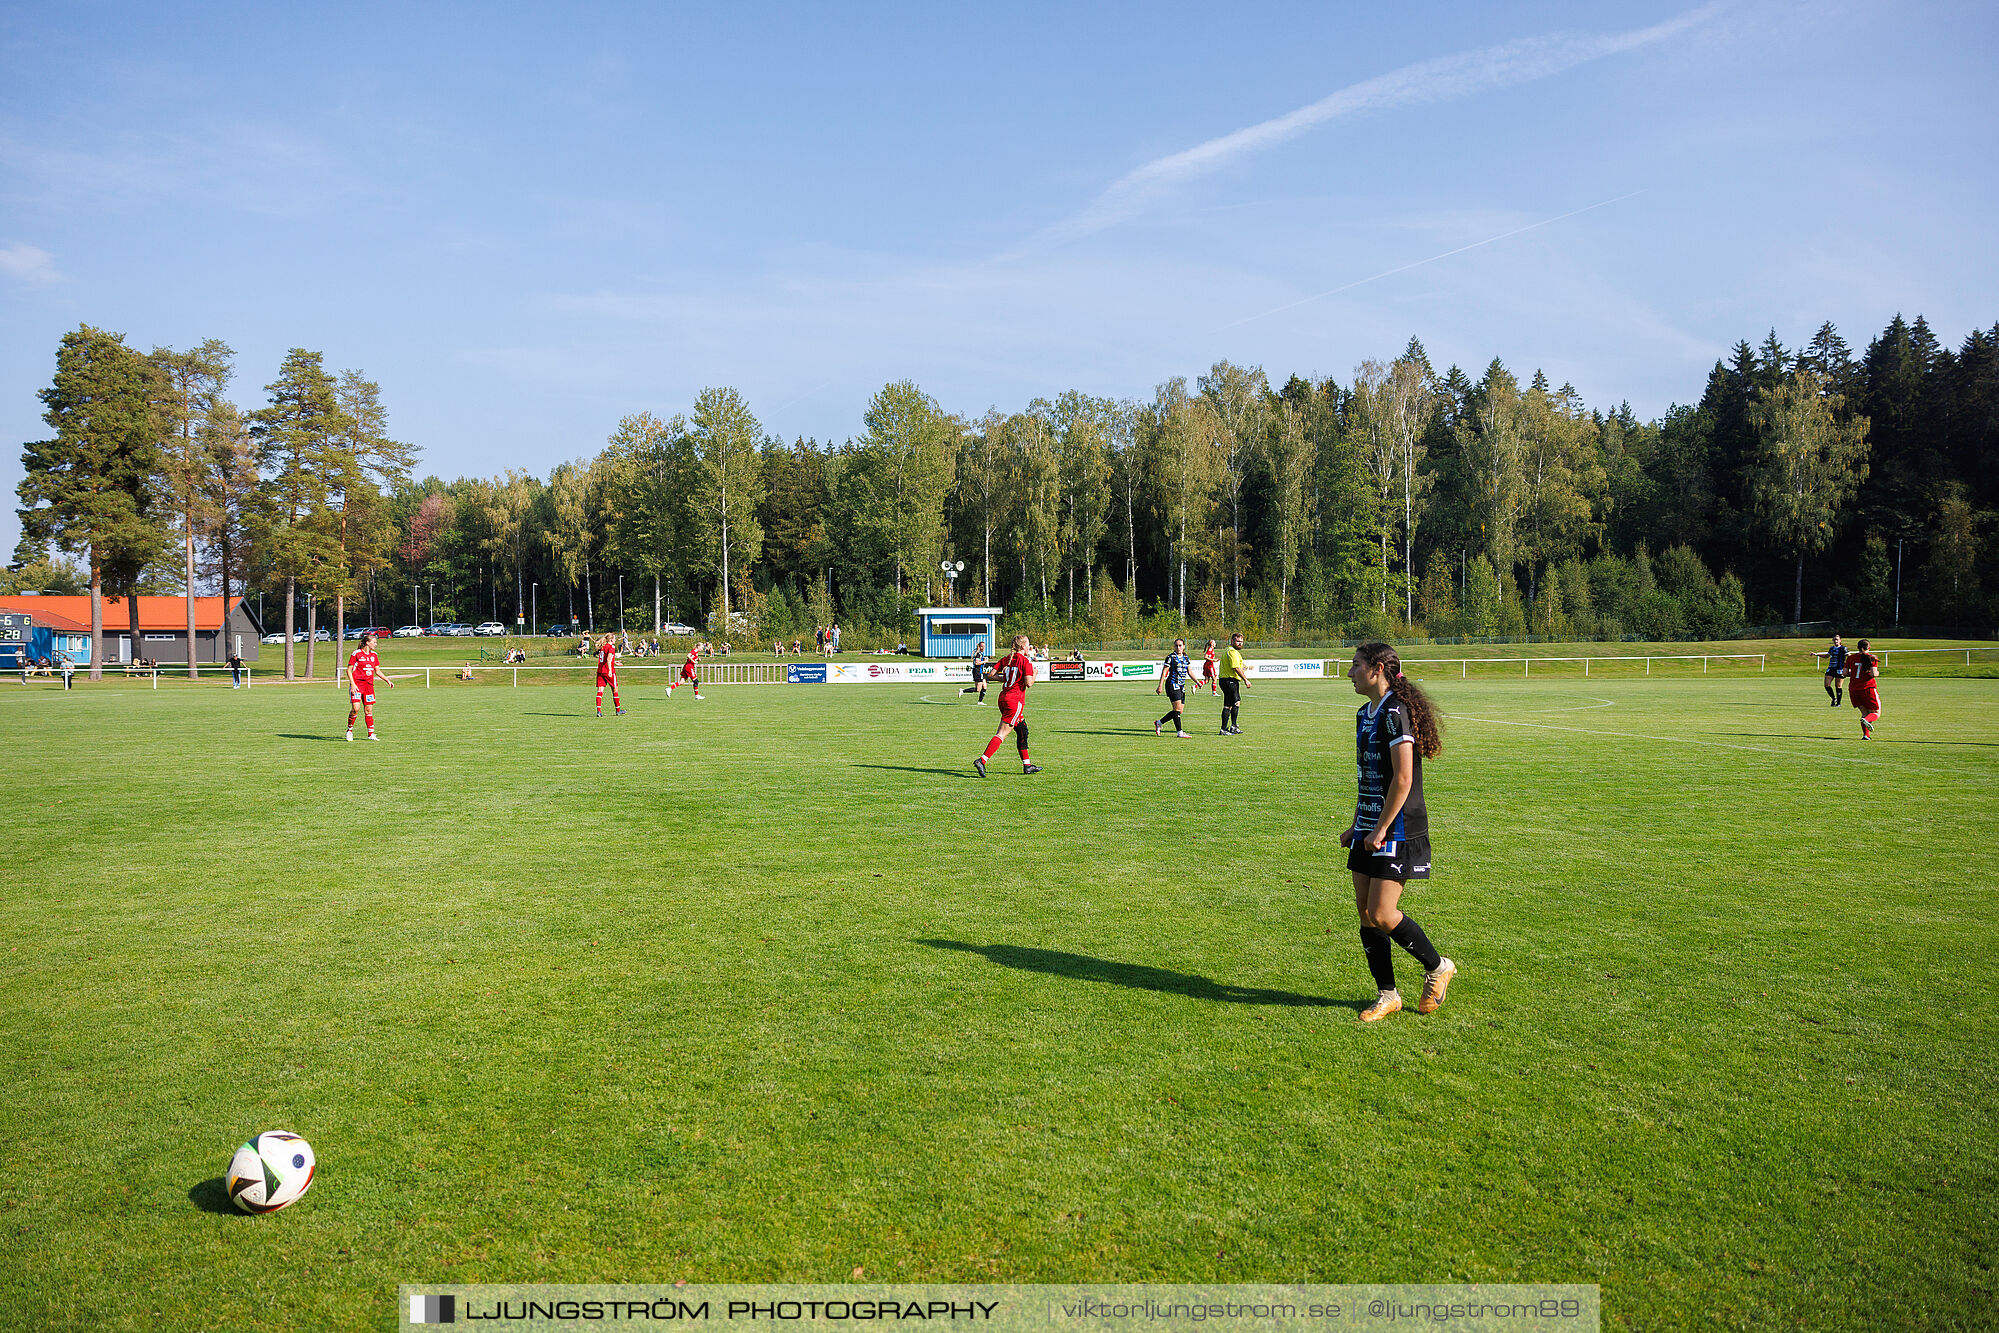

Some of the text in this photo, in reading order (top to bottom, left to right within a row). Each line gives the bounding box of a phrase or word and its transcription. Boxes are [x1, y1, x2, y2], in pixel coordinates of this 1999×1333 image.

[880, 666, 900, 675] VIDA
[1086, 665, 1120, 675] DALOC
[1299, 662, 1321, 670] STENA
[1854, 662, 1863, 679] 7
[1004, 666, 1018, 688] 17
